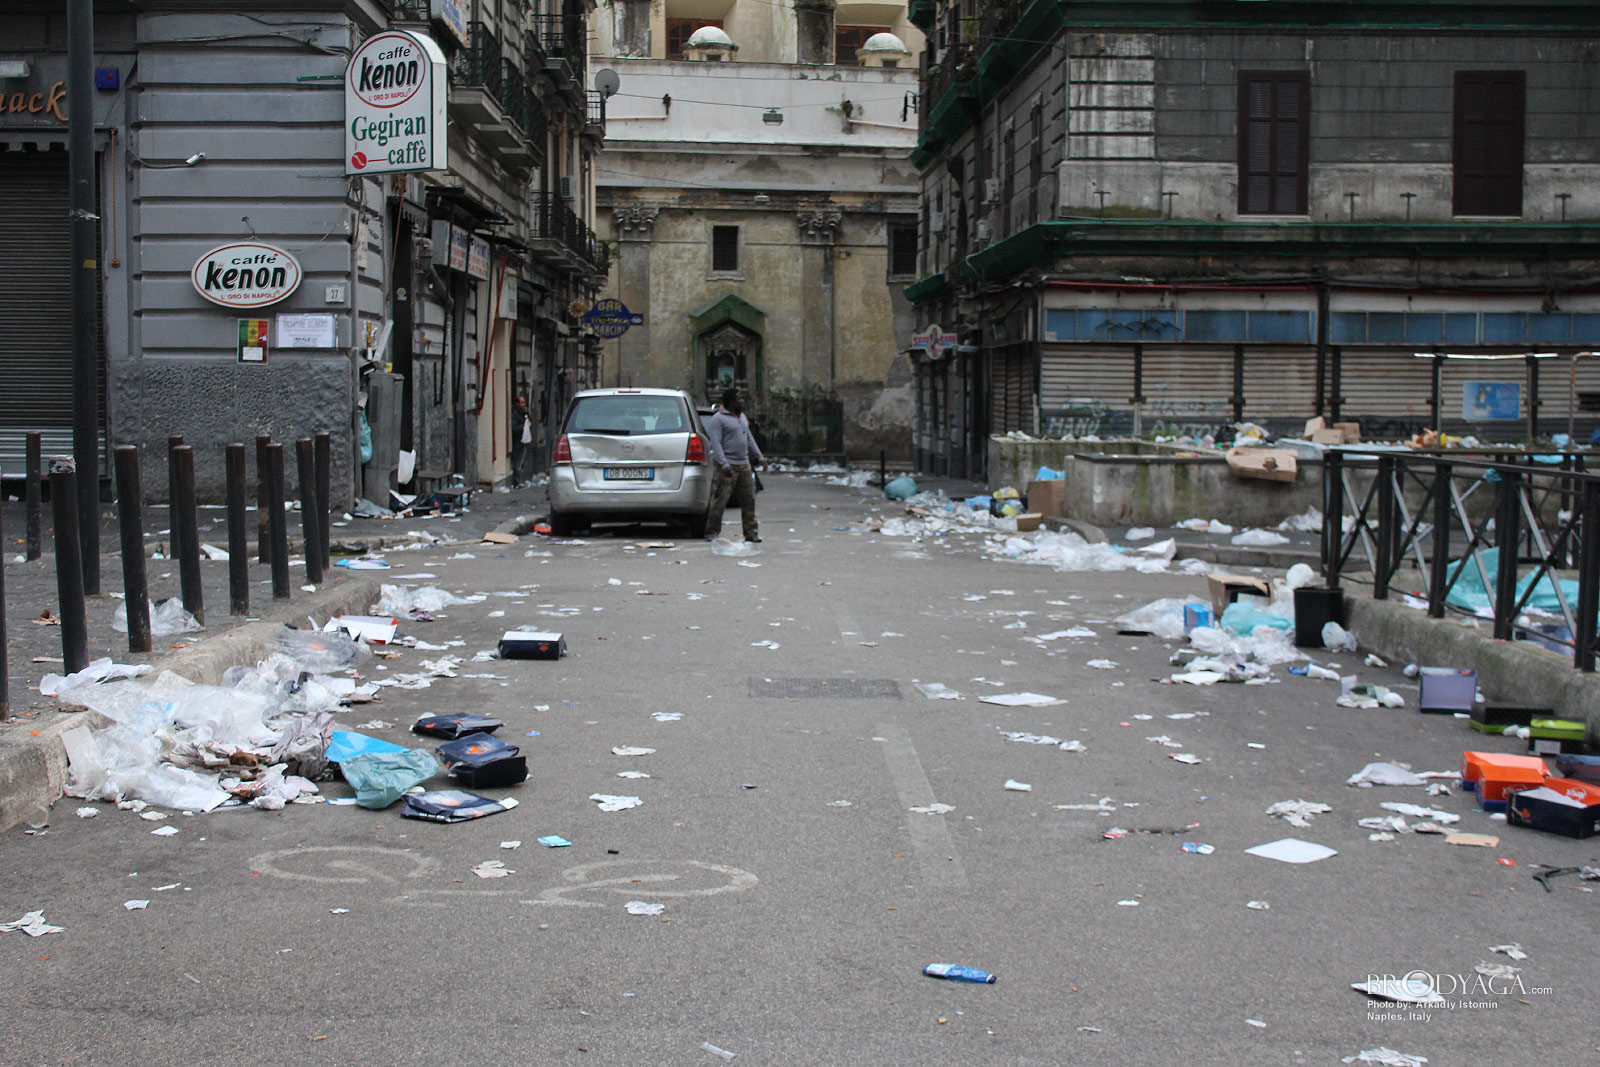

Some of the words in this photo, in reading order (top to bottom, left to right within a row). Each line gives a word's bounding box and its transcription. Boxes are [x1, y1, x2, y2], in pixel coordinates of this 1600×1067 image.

[359, 57, 419, 92] kenon
[351, 112, 426, 147] Gegiran
[388, 139, 426, 165] caffè
[204, 260, 286, 290] kenon
[597, 300, 622, 312] BAR
